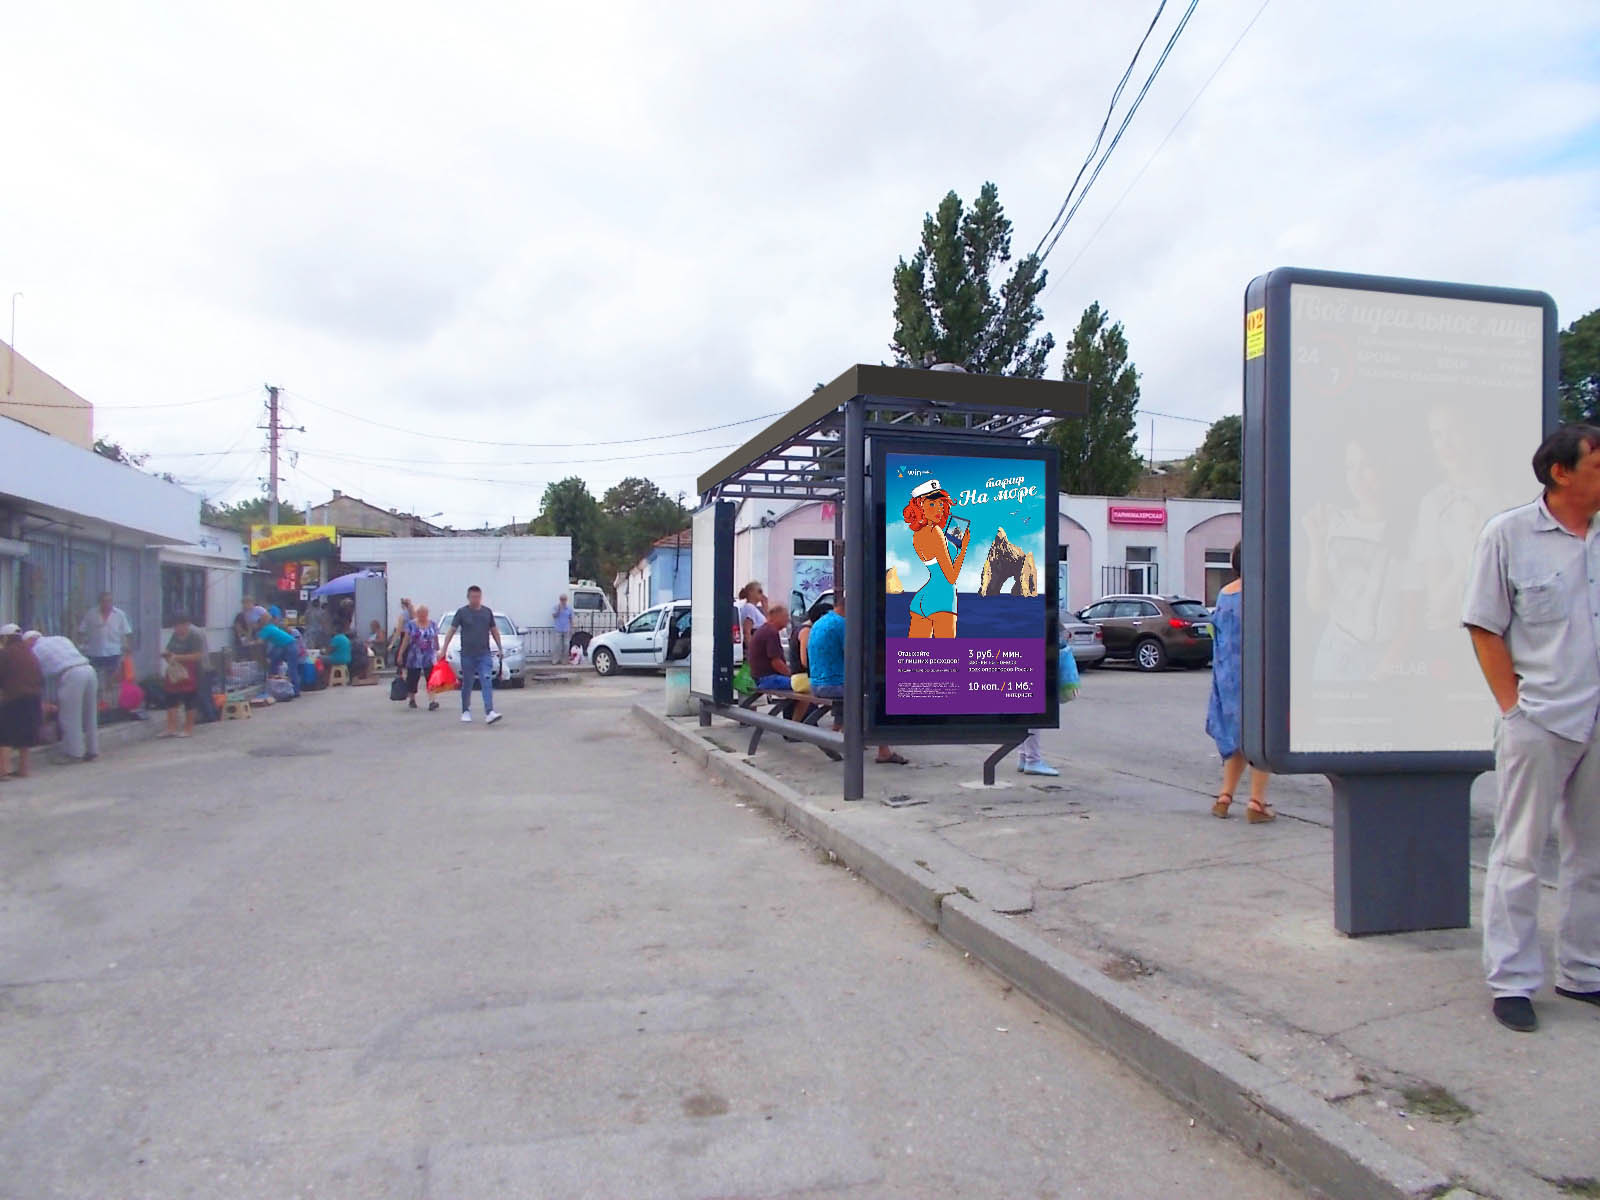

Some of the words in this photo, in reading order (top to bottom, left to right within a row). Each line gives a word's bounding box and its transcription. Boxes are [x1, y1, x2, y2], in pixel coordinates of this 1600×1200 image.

[985, 476, 1025, 489] тариф
[958, 490, 990, 506] На
[993, 485, 1038, 504] море
[968, 649, 974, 658] 3
[976, 649, 994, 659] руб.
[968, 682, 979, 691] 10
[981, 683, 1000, 691] коп.
[1007, 682, 1012, 691] 1
